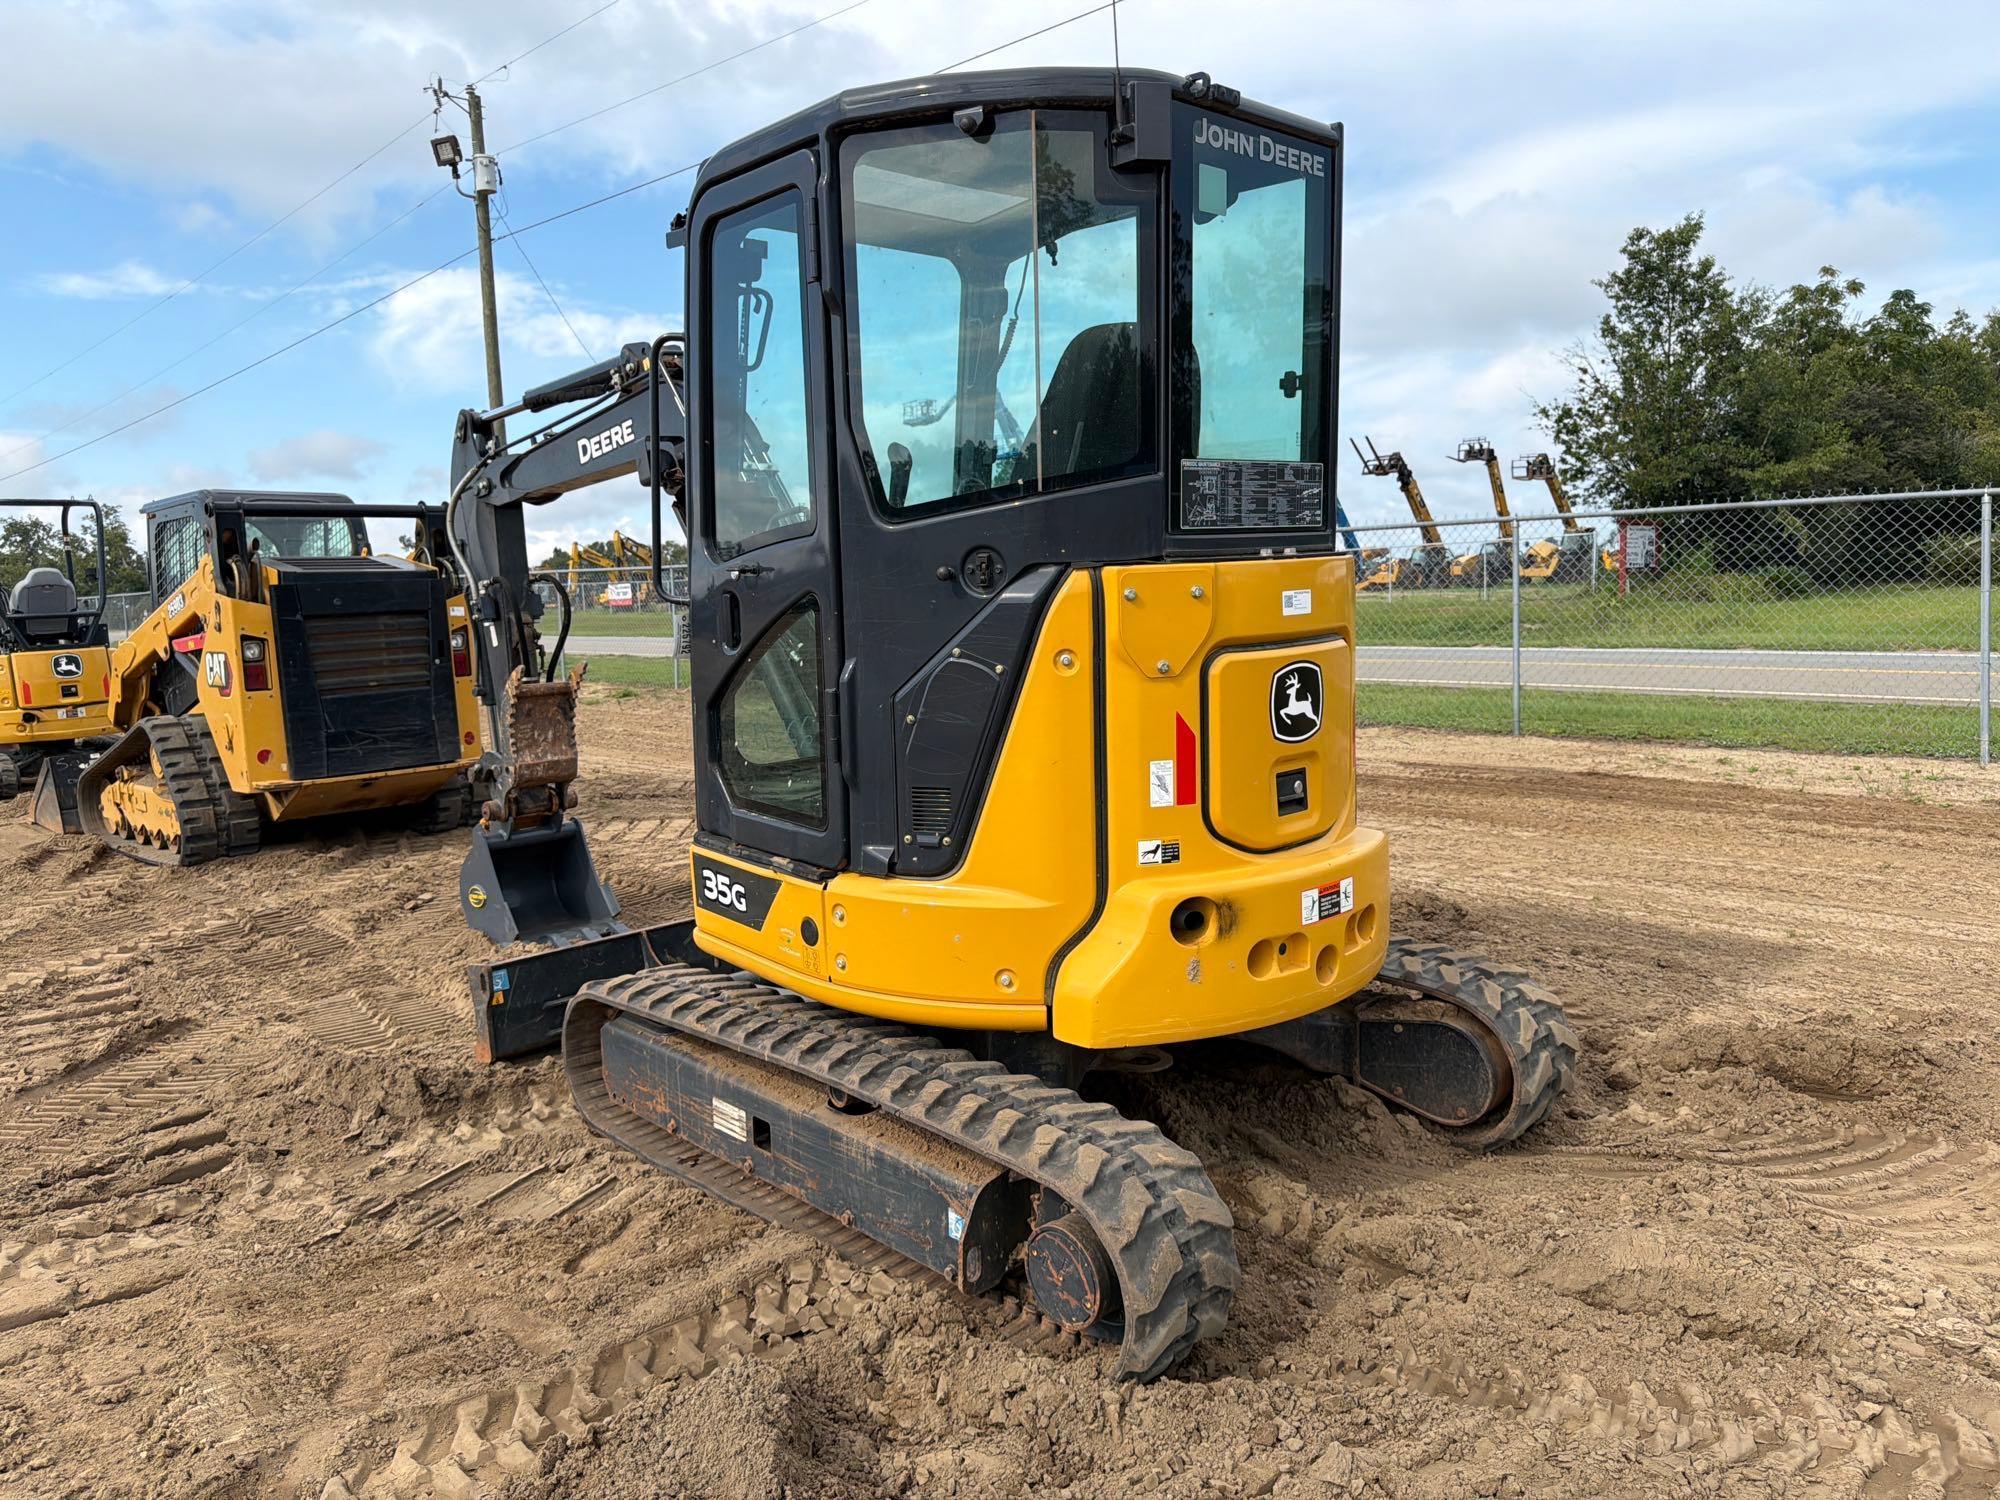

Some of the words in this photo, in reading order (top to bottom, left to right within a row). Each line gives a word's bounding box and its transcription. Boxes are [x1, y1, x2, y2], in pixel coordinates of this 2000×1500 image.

[1195, 117, 1253, 157] JOHN
[1259, 135, 1325, 177] DEERE
[577, 419, 635, 465] DEERE
[205, 652, 227, 687] CAT
[702, 869, 747, 912] 35G
